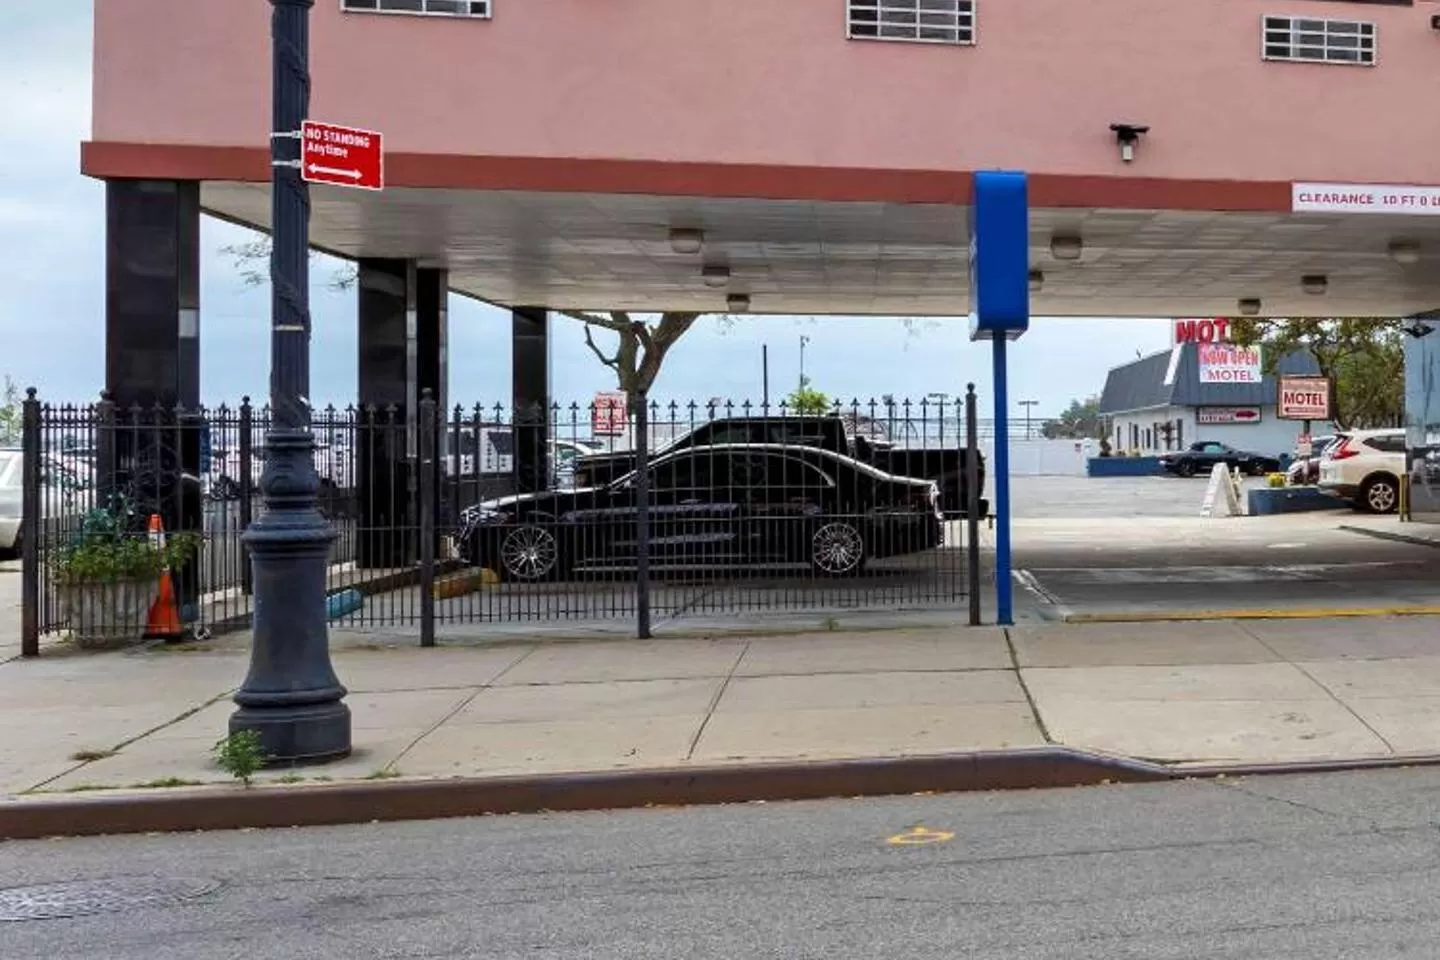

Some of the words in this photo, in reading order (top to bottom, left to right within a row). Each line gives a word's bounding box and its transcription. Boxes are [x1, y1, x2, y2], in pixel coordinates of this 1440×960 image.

[306, 127, 321, 140] NO
[323, 130, 370, 148] STANDING
[307, 141, 348, 158] Anytime
[1299, 193, 1374, 205] CLEARANCE
[1383, 195, 1397, 204] 10
[1401, 195, 1415, 206] FT
[1176, 317, 1231, 344] MOT
[1230, 350, 1259, 366] OPEN
[1209, 370, 1254, 381] MOTEL
[1284, 391, 1325, 406] MOTEL
